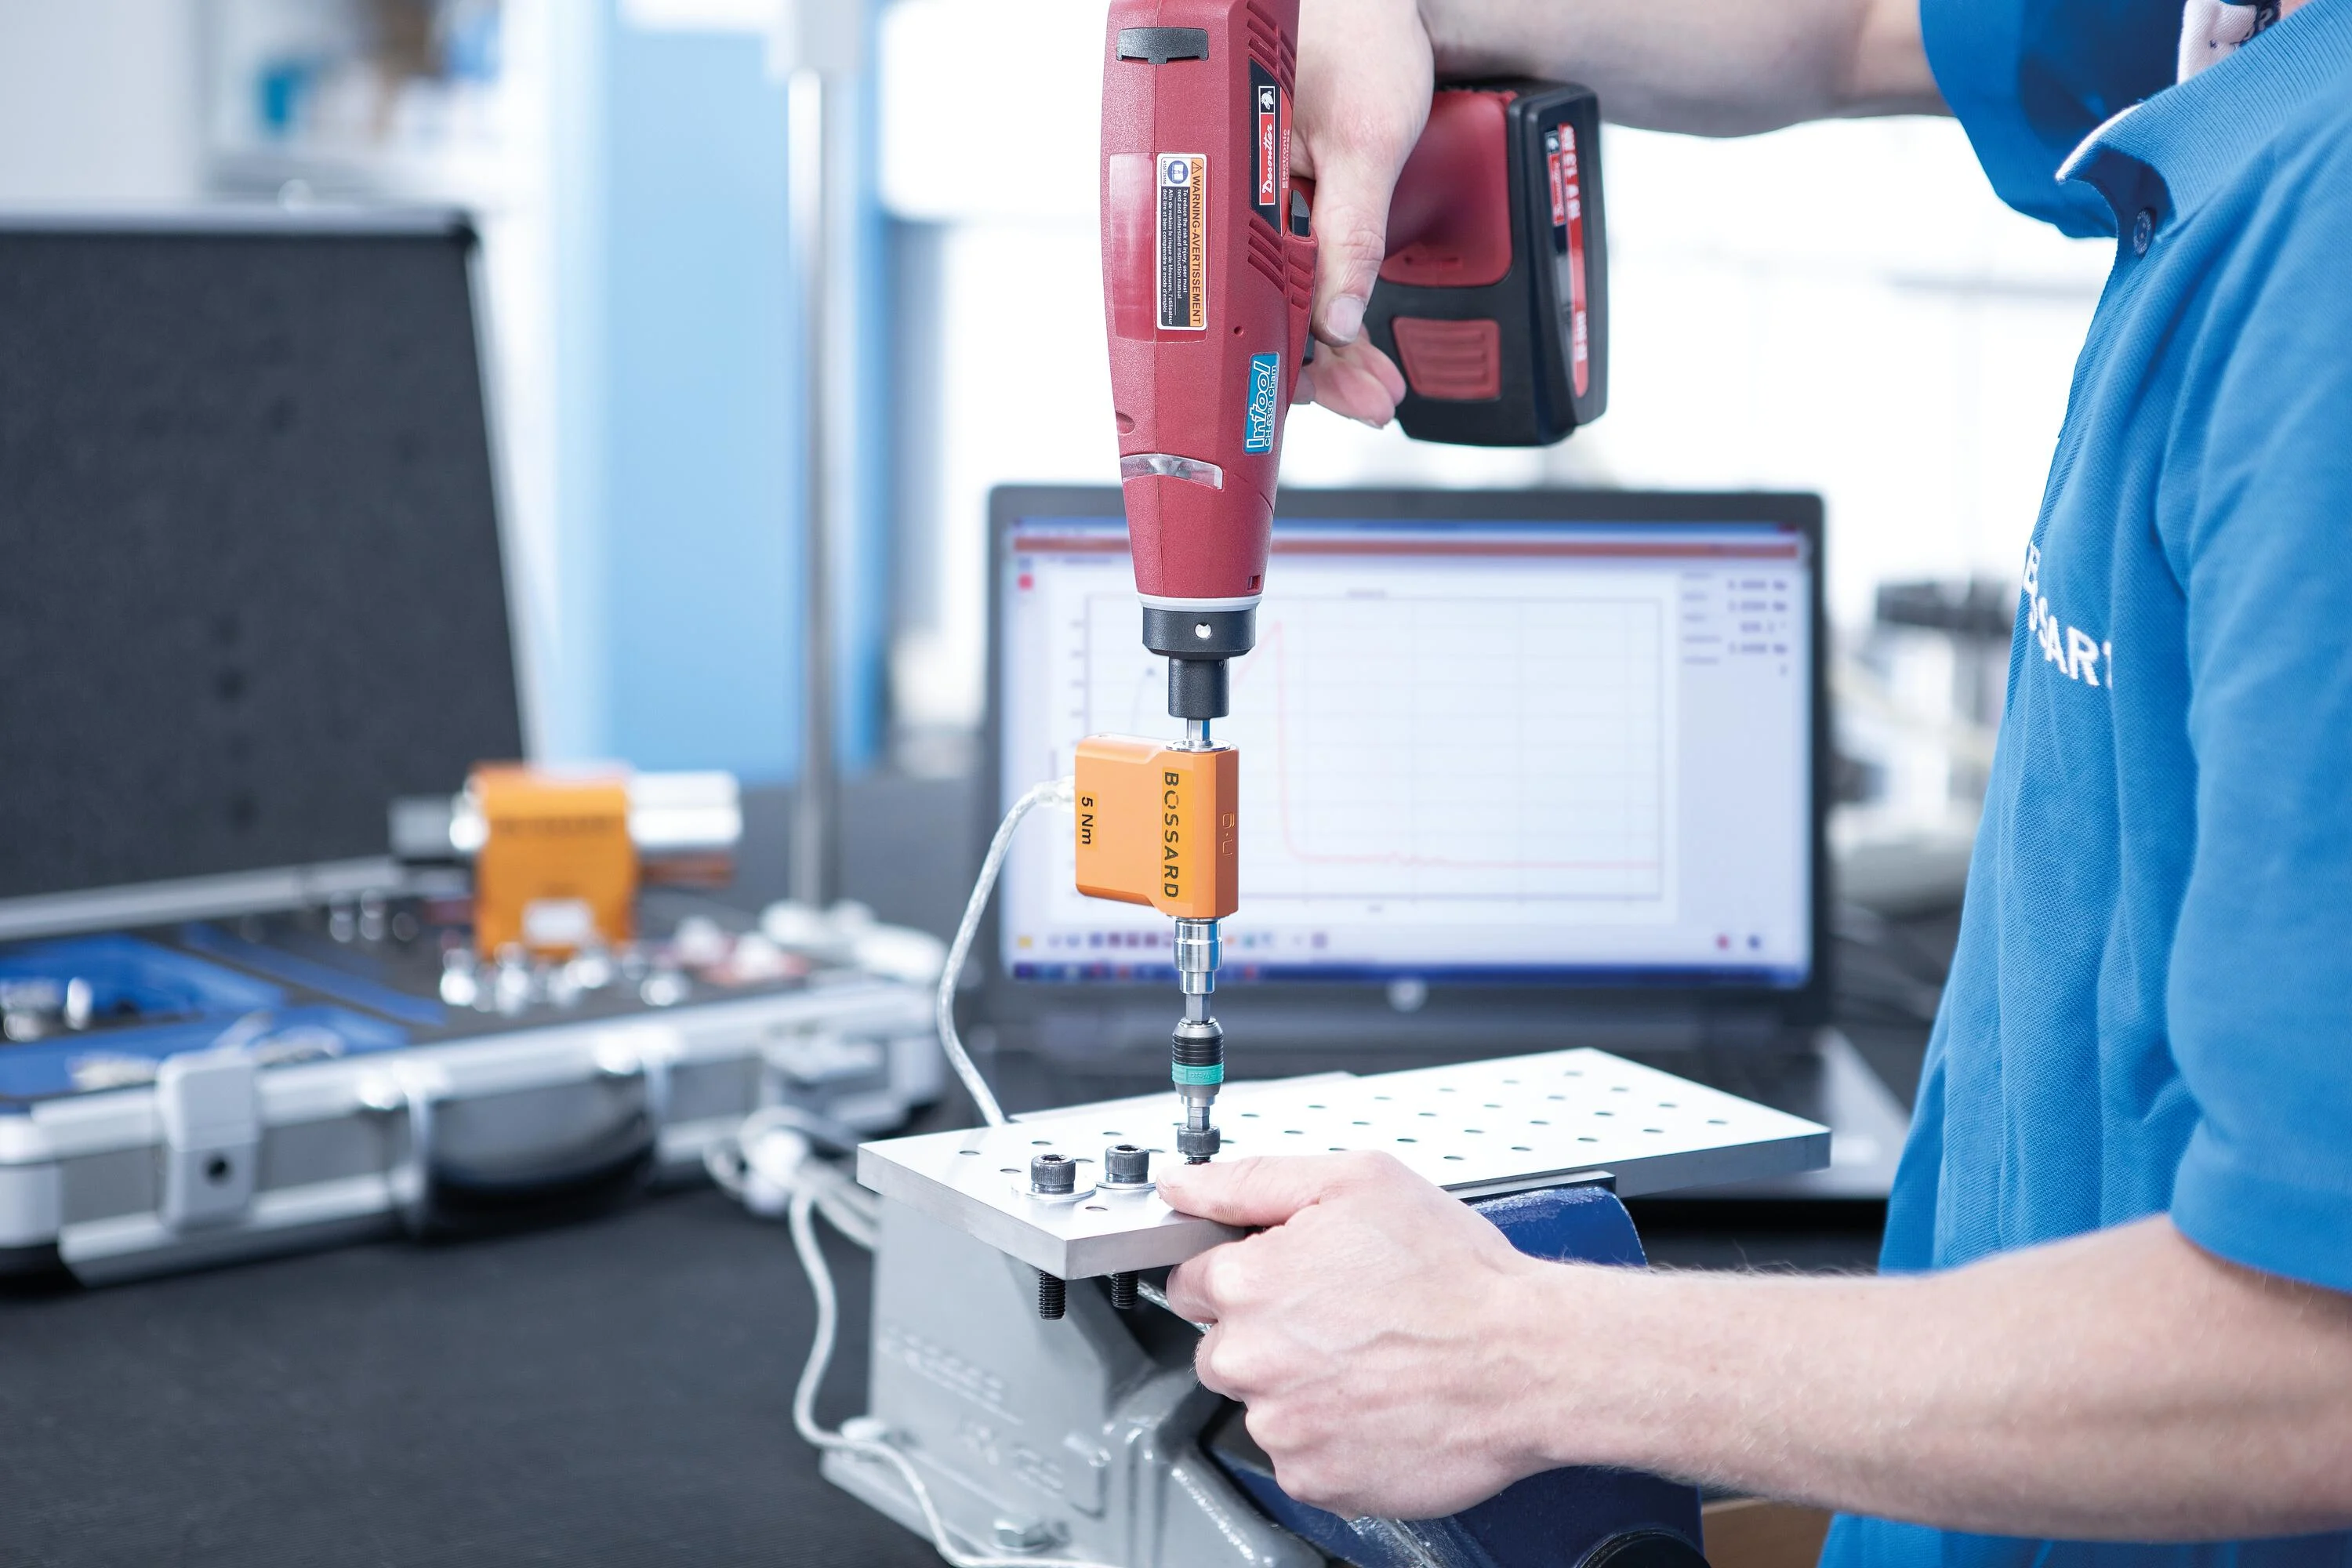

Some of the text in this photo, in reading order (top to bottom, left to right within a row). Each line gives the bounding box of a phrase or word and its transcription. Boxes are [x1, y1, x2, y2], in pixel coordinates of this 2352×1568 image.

[1262, 123, 1273, 194] Desoutter
[1247, 361, 1270, 448] Intool
[1265, 365, 1277, 447] CH-6330 Cham
[1082, 797, 1094, 844] 5 Nm
[1164, 771, 1179, 898] BOSSARD
